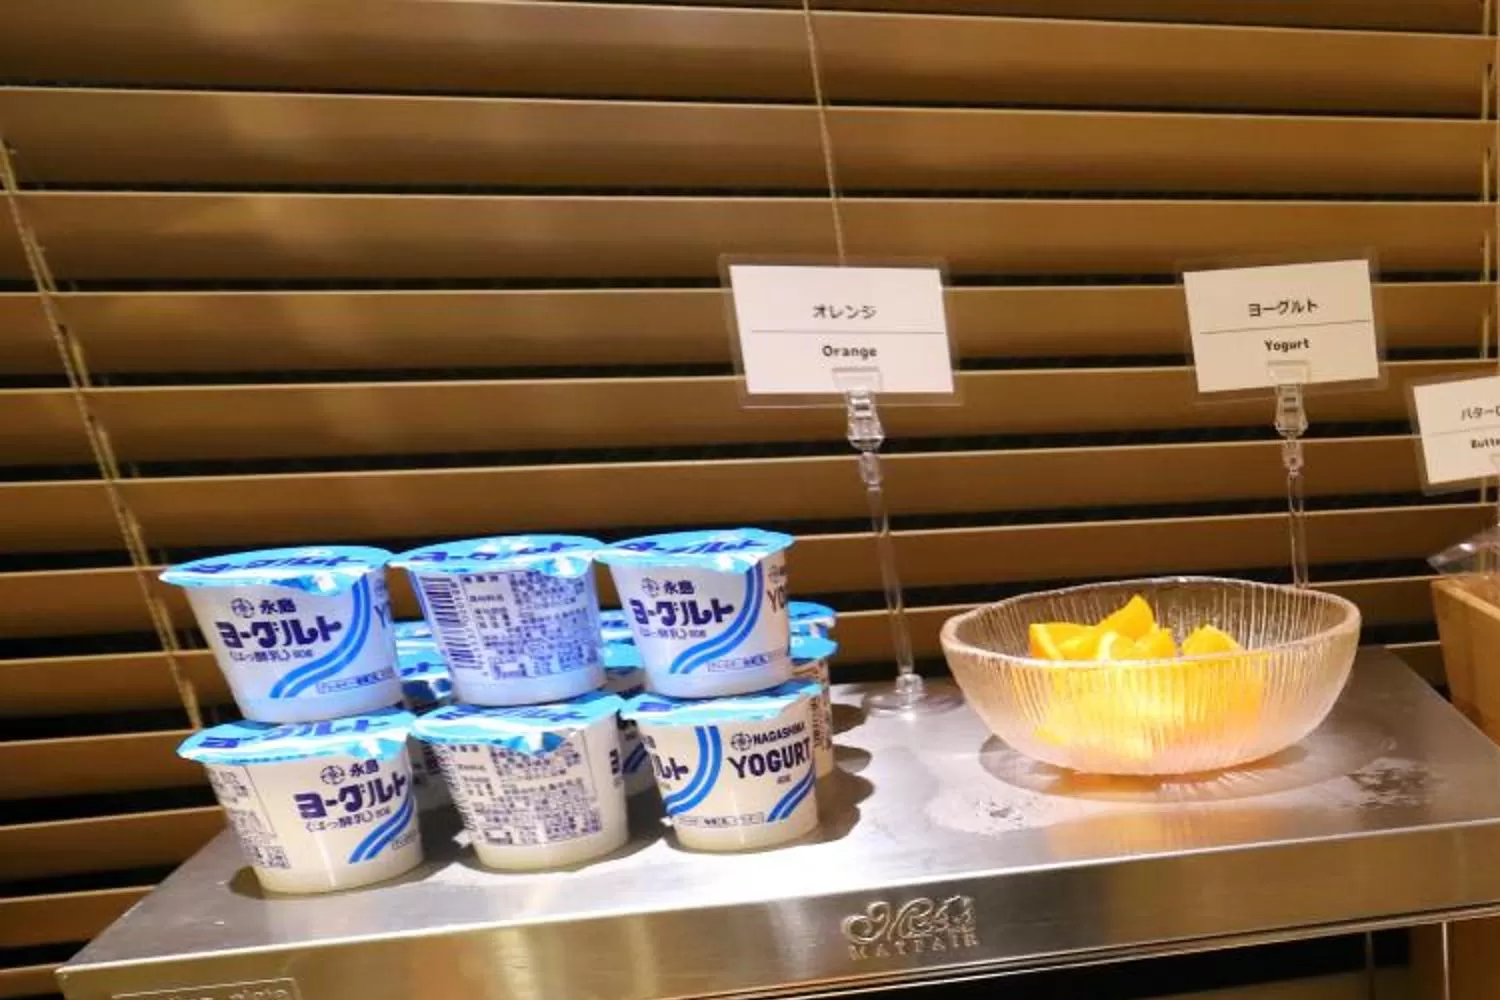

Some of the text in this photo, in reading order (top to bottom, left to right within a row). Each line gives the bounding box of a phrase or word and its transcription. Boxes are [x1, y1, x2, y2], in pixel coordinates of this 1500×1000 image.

[811, 304, 877, 319] オレンジ
[1247, 298, 1319, 317] ヨーグルト
[821, 345, 878, 360] Orange
[1263, 338, 1311, 353] Yogurt
[629, 598, 736, 626] ヨーグルト
[214, 615, 343, 649] ヨーグルト
[728, 736, 811, 779] YOGURT
[294, 771, 407, 819] ヨーグルト
